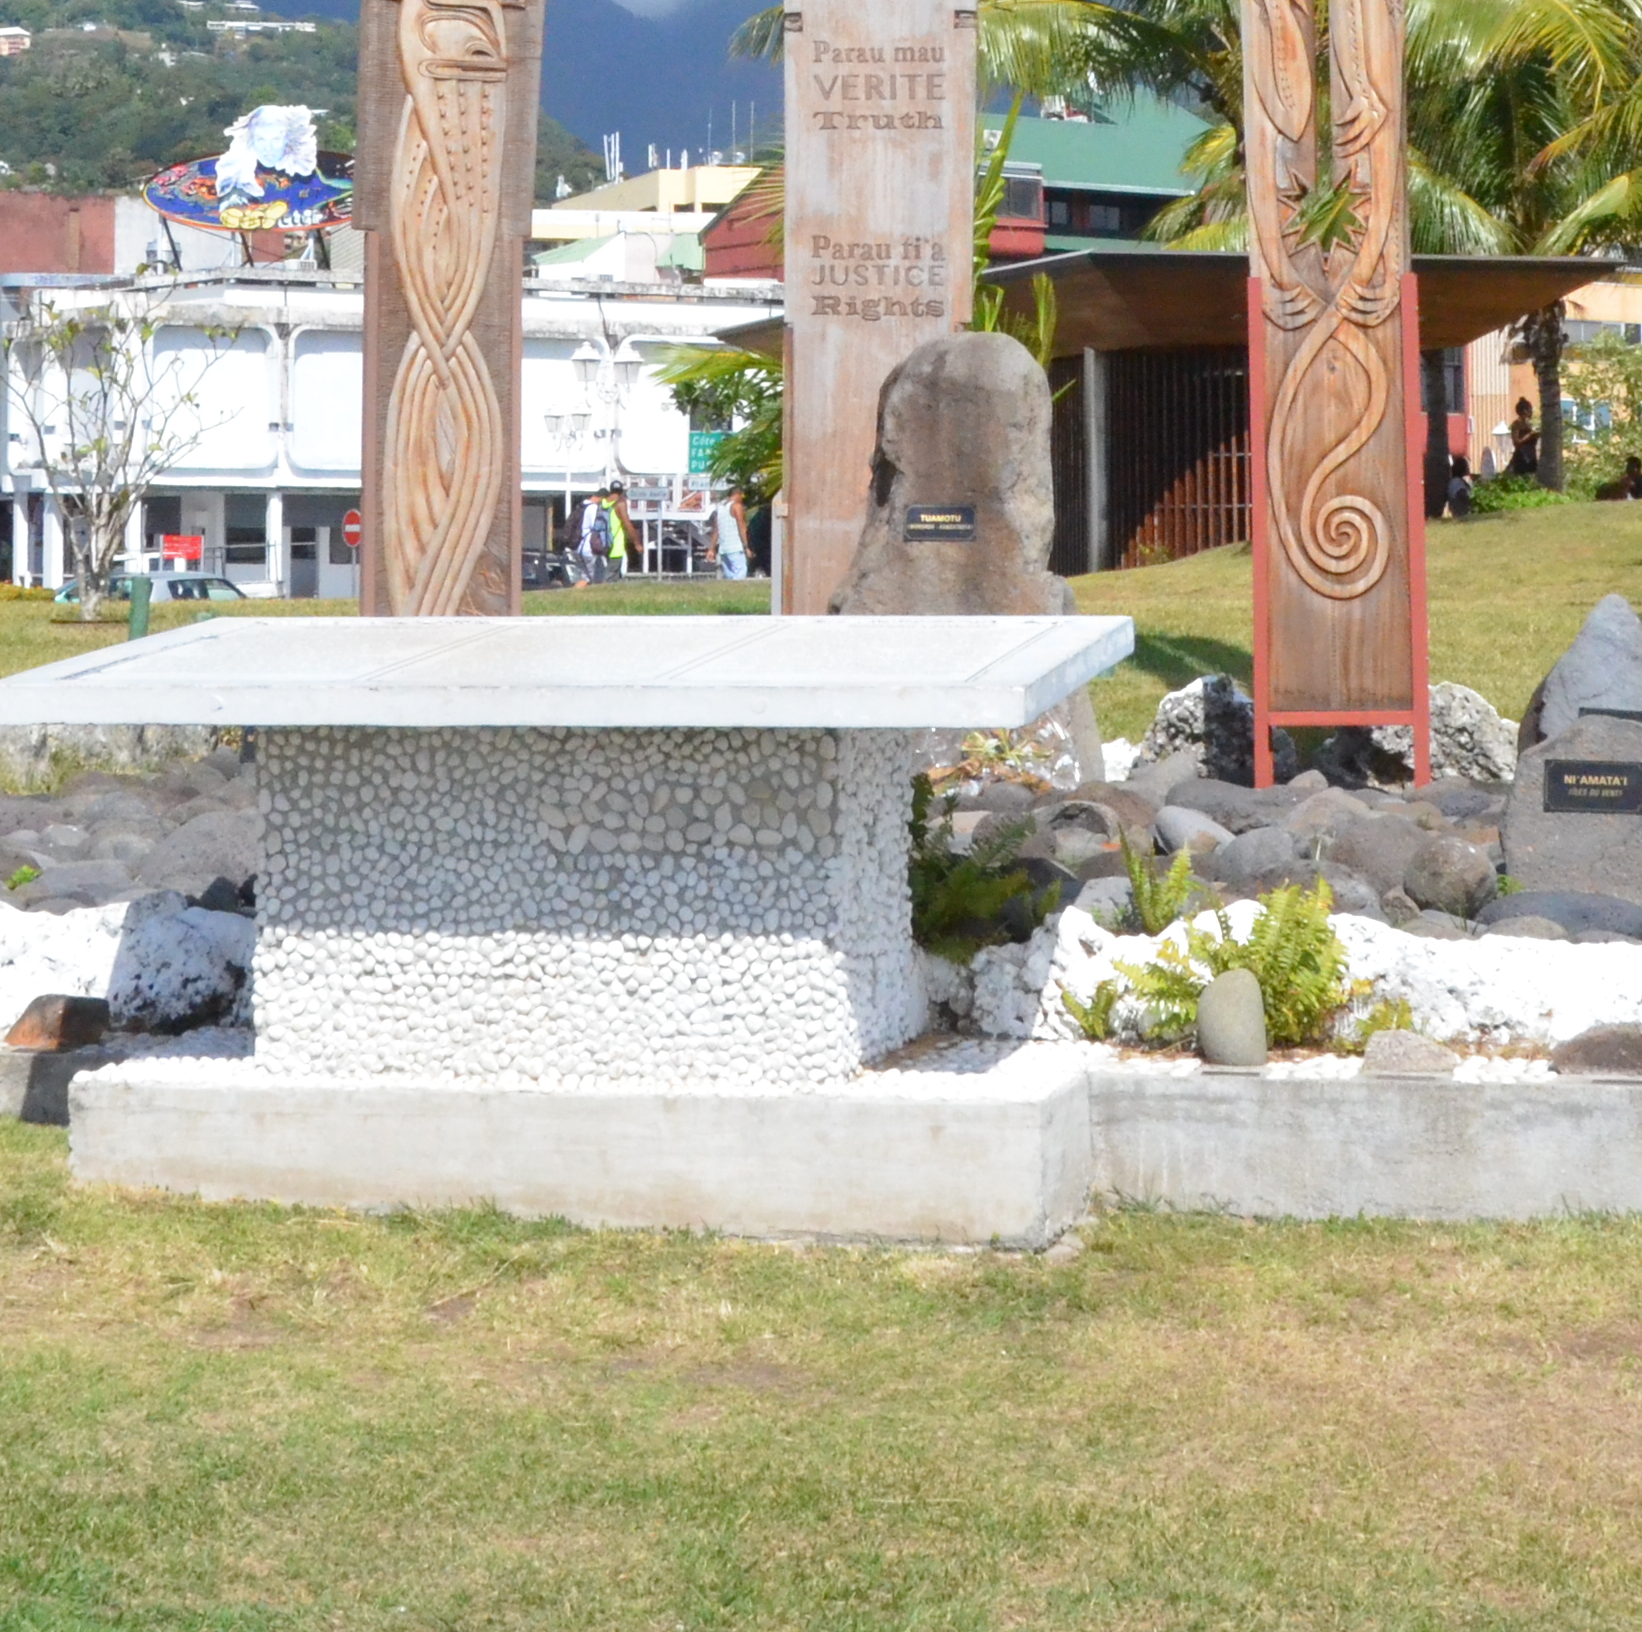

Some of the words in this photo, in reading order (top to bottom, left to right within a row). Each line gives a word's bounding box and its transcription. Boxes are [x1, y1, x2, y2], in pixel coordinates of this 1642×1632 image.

[812, 39, 886, 63] Parau
[894, 46, 945, 63] mau
[813, 73, 946, 101] VERITE
[812, 111, 943, 130] Truth
[811, 235, 892, 261] Parau
[811, 264, 944, 286] JUSTICE
[811, 295, 945, 321] Rights
[920, 514, 962, 522] TUAMOTU
